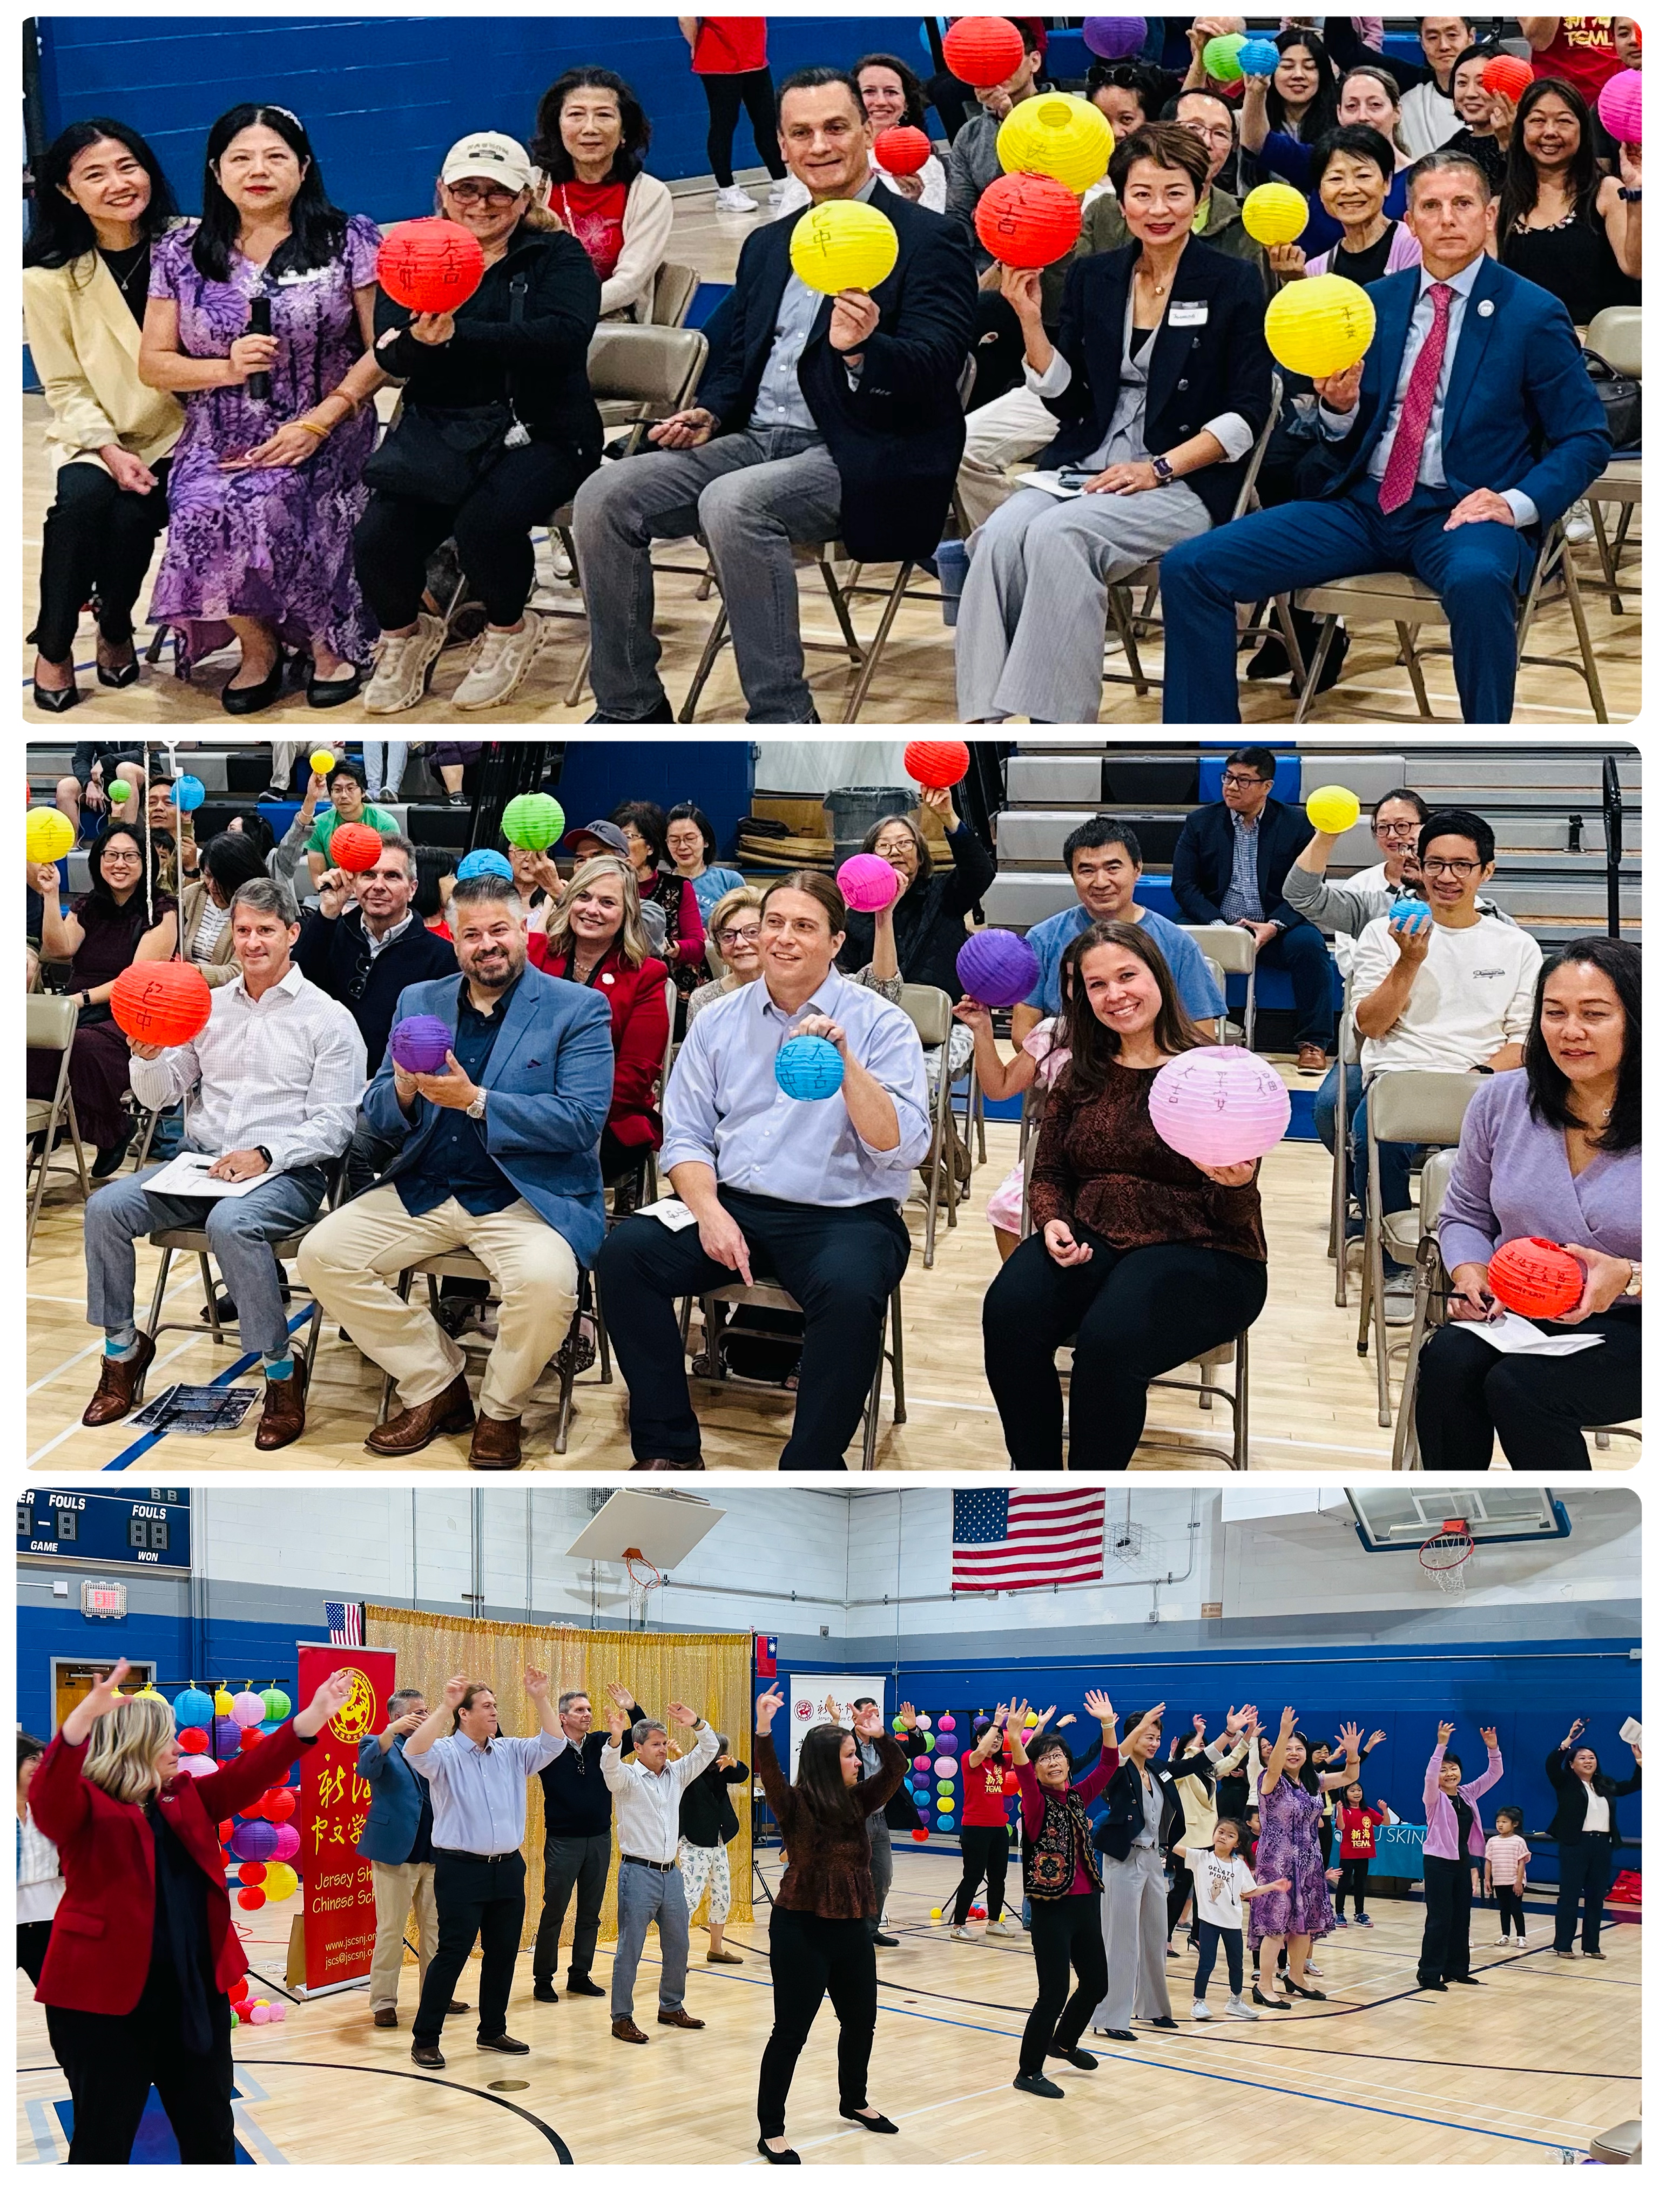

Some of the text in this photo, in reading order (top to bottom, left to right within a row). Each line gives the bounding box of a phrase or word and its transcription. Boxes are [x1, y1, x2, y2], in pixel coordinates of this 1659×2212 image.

[437, 238, 463, 284] 大吉
[810, 1043, 828, 1089] 大吉
[1169, 1065, 1197, 1104] 大吉
[1252, 1070, 1278, 1096] 福
[1213, 1071, 1228, 1112] 平安
[49, 1494, 86, 1510] FOULS
[132, 1505, 166, 1520] FOULS
[30, 1541, 58, 1553] GAME
[138, 1551, 159, 1562] WON
[985, 1774, 1003, 1785] 新海
[1351, 1829, 1371, 1840] 新海
[1386, 1828, 1424, 1845] SKIN
[1208, 1865, 1235, 1878] GELATO
[1209, 1871, 1231, 1883] PIQUE
[315, 1872, 354, 1890] Jersey
[312, 1887, 375, 1913] Chinese Sch
